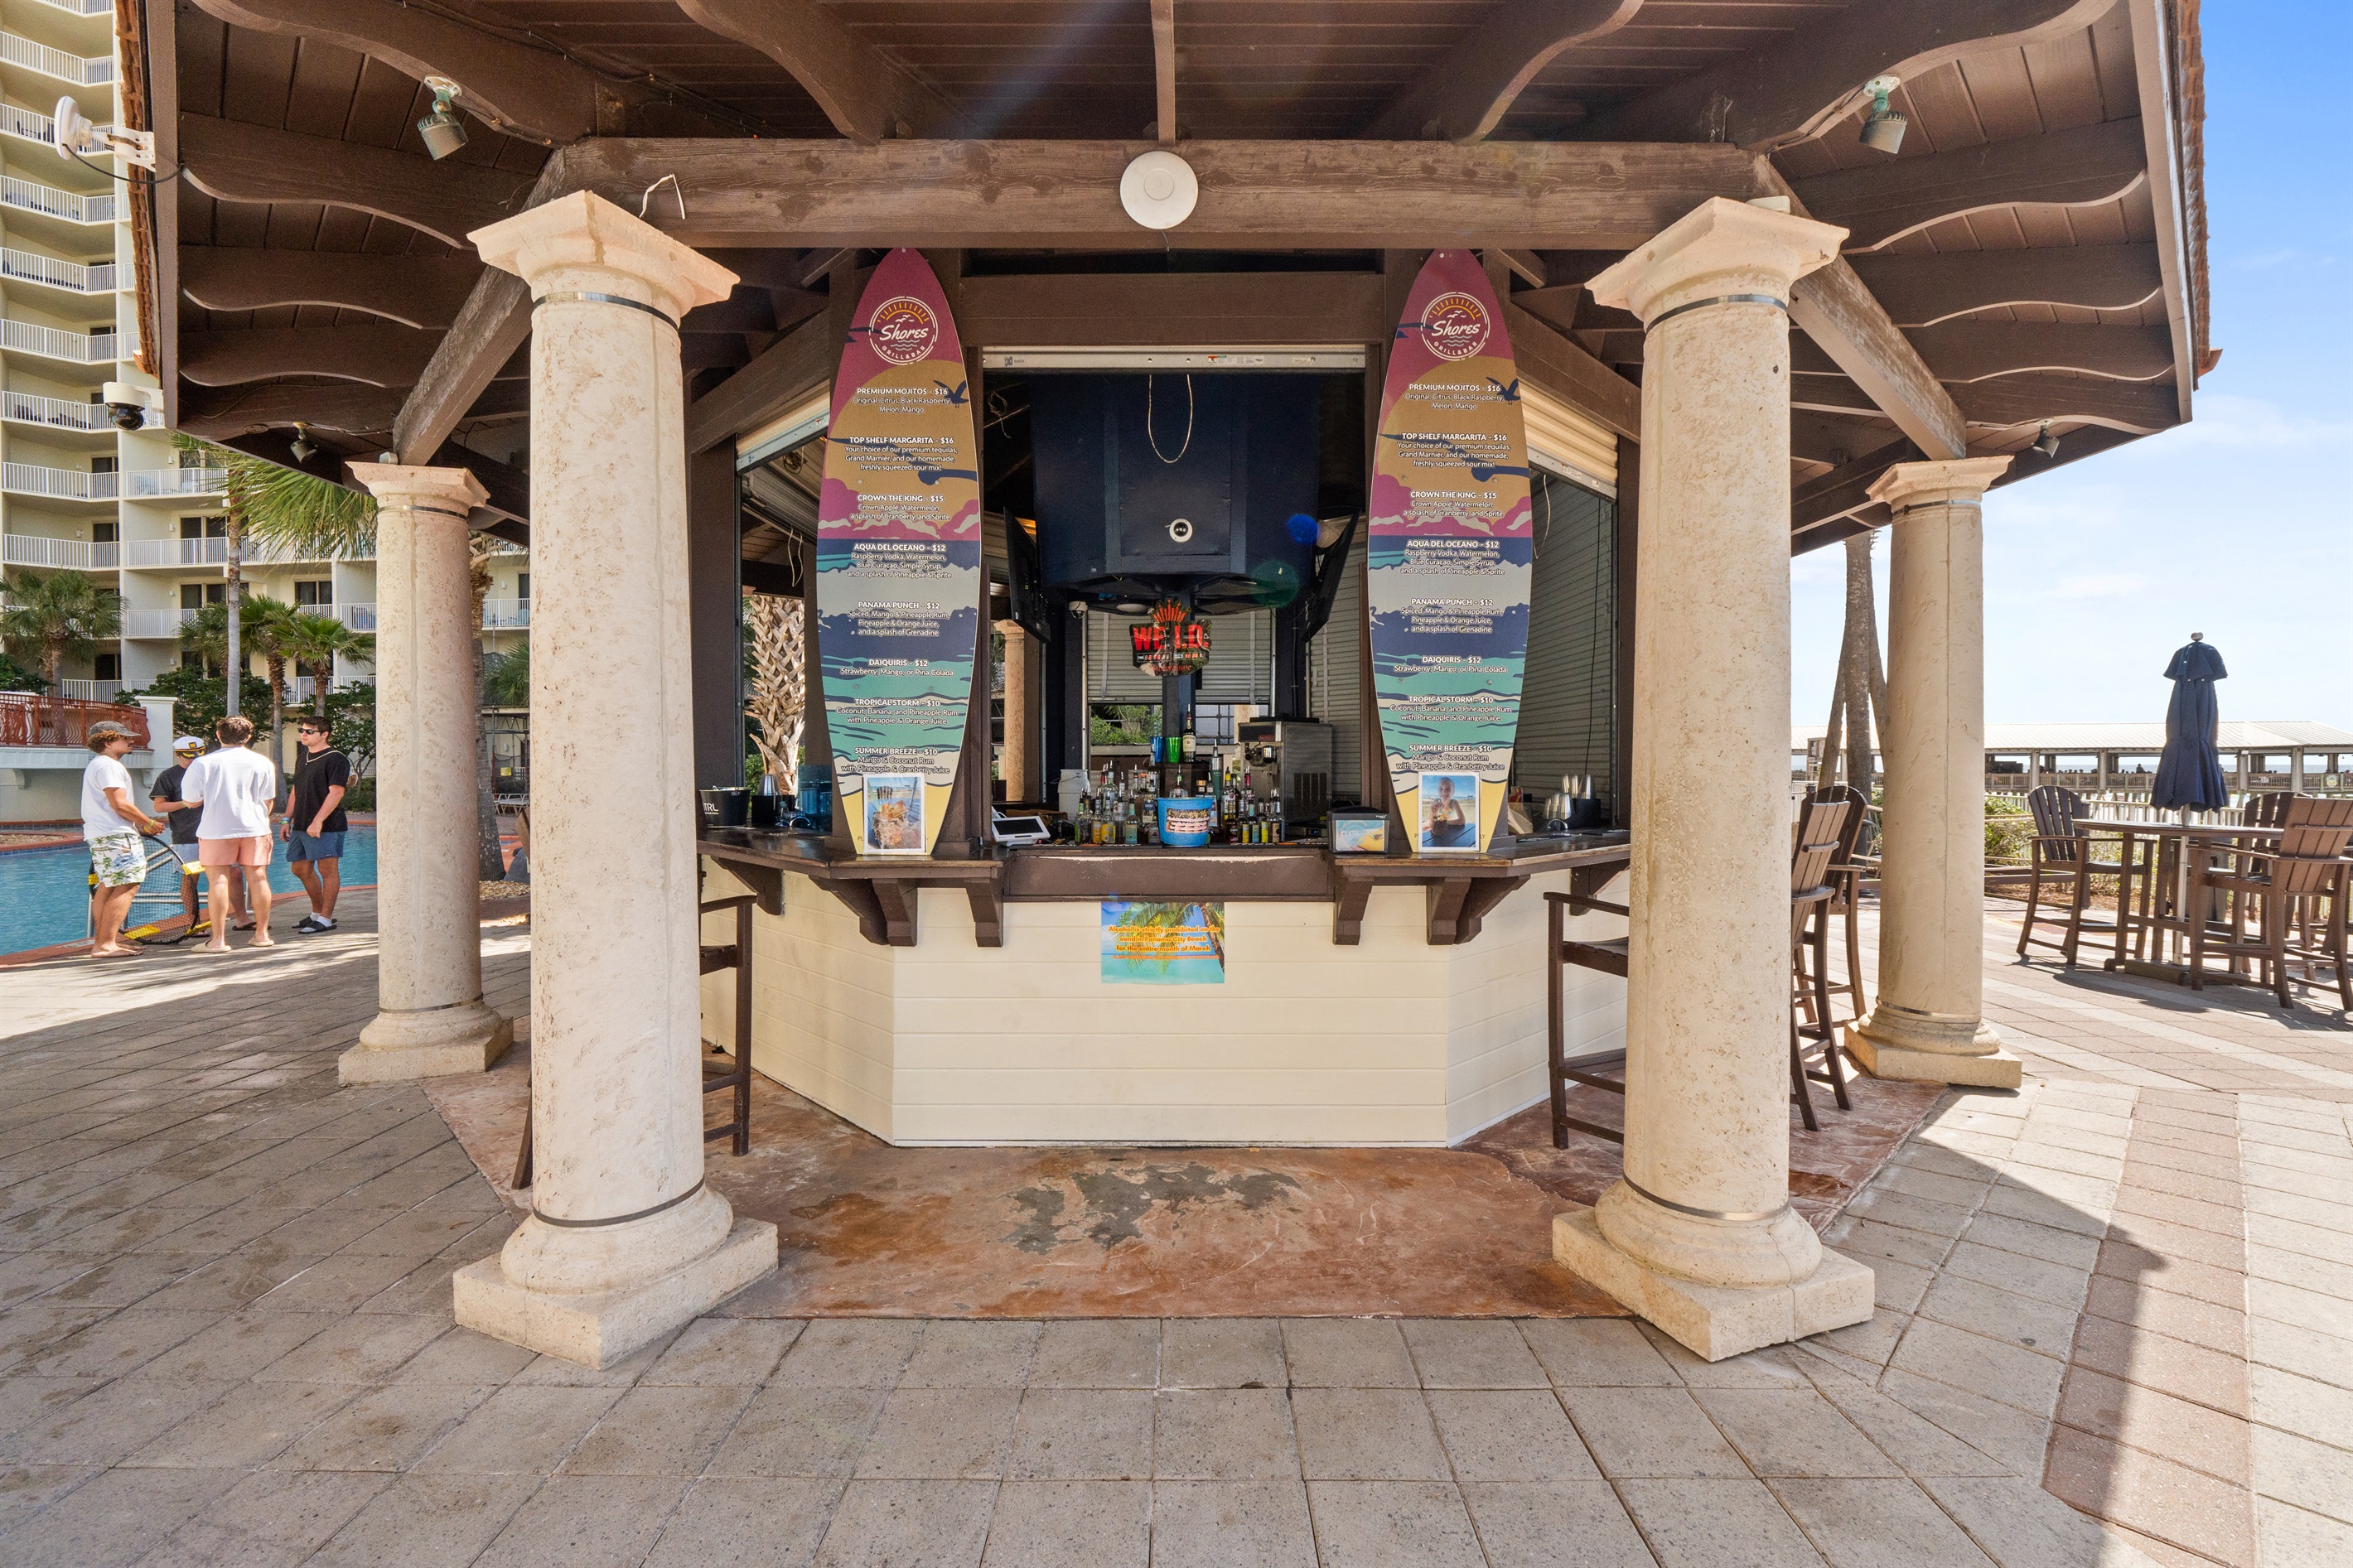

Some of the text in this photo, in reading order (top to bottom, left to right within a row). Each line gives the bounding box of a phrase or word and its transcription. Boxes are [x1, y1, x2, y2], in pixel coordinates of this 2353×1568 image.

[879, 323, 929, 340] Shores
[1431, 319, 1481, 336] Shores
[901, 406, 925, 414] Mango
[940, 437, 954, 445] $16
[1133, 625, 1165, 651] WE
[910, 708, 941, 716] Pineapple
[1141, 925, 1163, 934] strictly
[1165, 925, 1199, 934] prohibited
